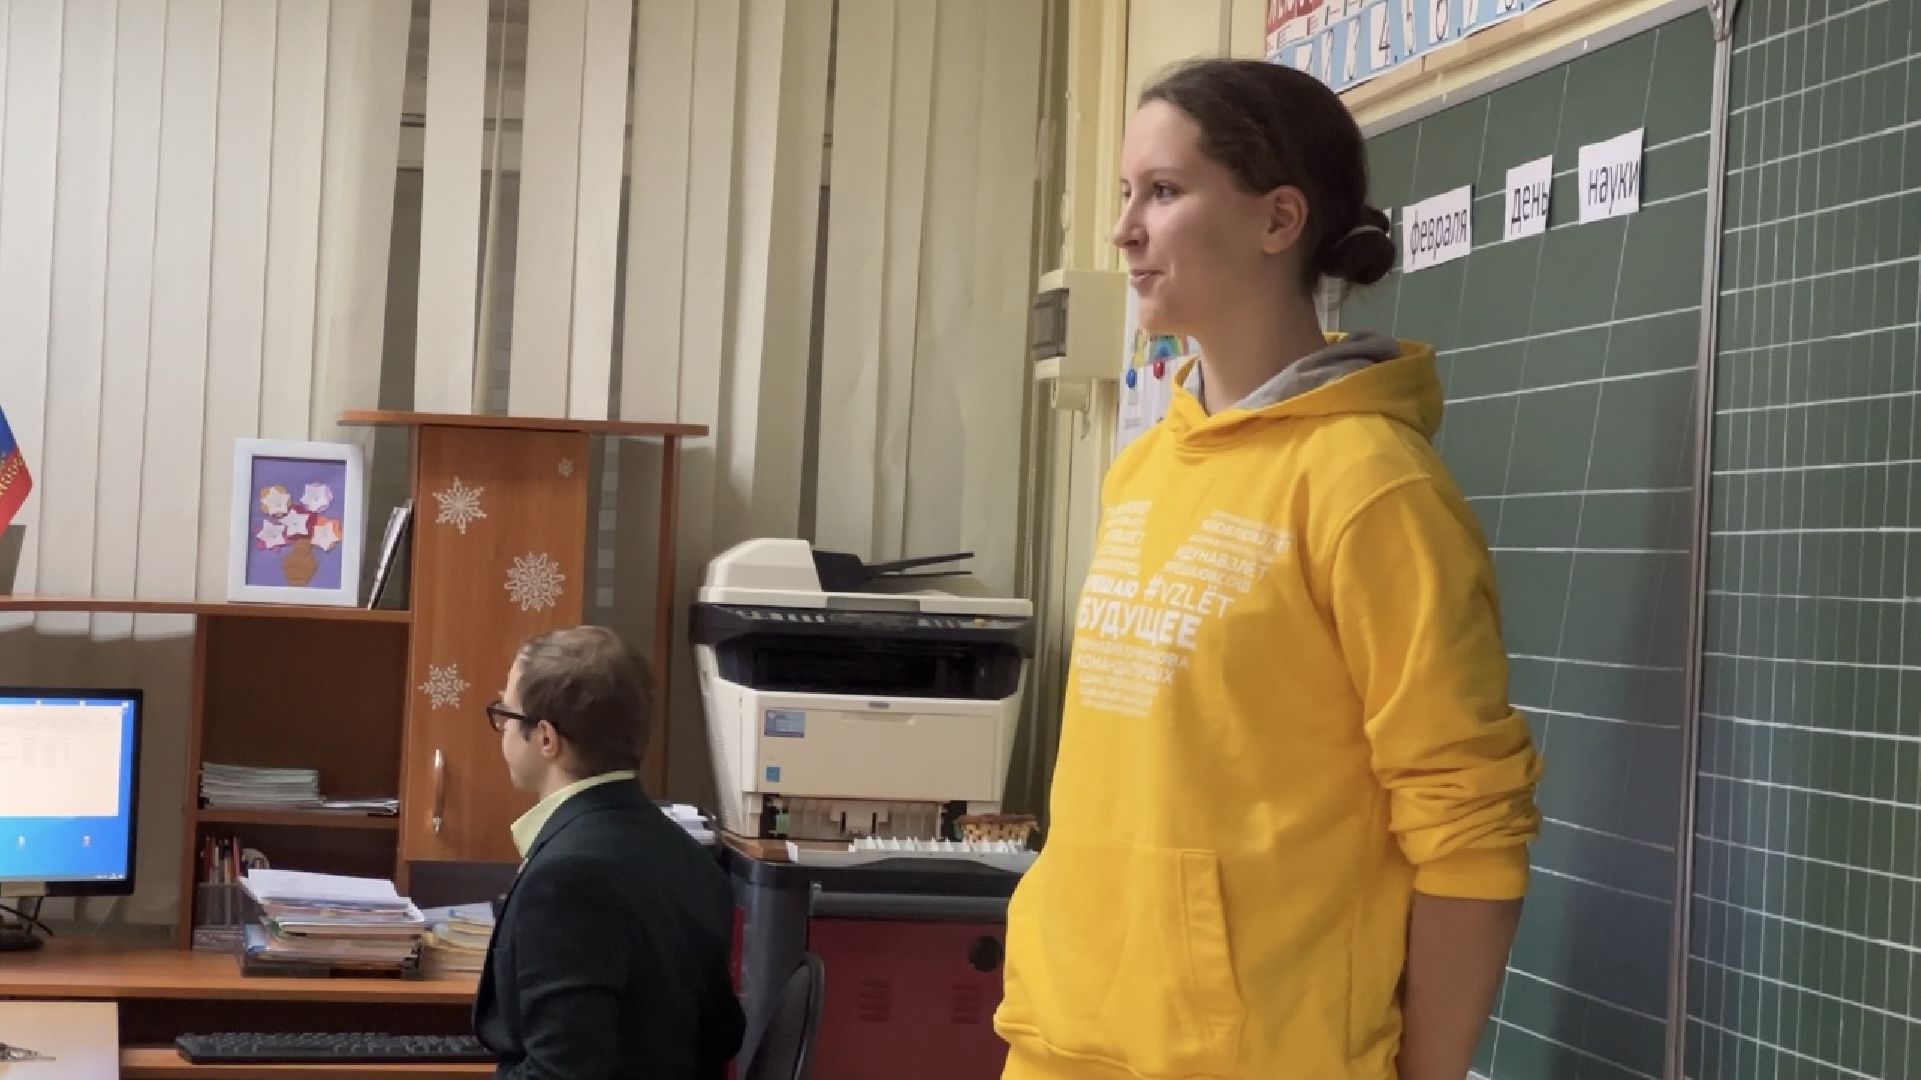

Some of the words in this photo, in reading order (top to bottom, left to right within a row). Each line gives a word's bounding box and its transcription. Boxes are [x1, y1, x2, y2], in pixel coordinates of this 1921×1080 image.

[1410, 209, 1468, 265] февраля
[1511, 180, 1550, 235] день
[1588, 159, 1639, 215] науки
[1076, 595, 1203, 650] БУДУЩЕЕ
